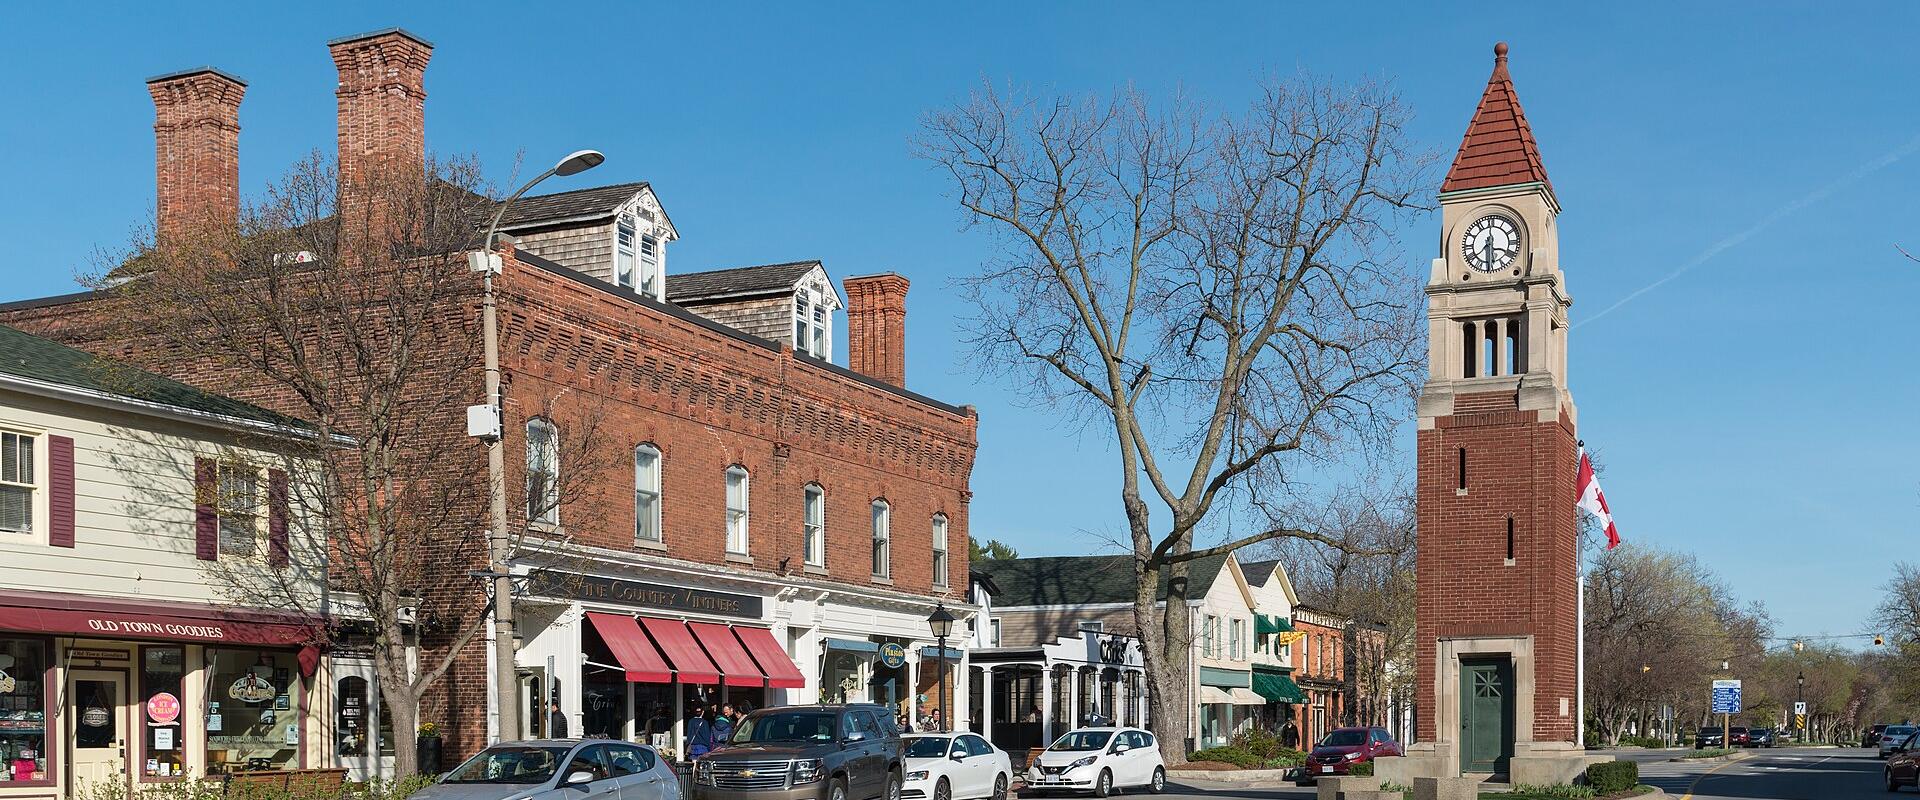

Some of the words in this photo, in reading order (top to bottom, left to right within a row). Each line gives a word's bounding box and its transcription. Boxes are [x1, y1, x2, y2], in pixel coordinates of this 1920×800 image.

[611, 580, 676, 606] COUNTRY
[680, 589, 740, 612] VINTNERS
[88, 619, 119, 631] OLD
[120, 621, 164, 634] TOWN
[165, 624, 224, 638] GOODIES
